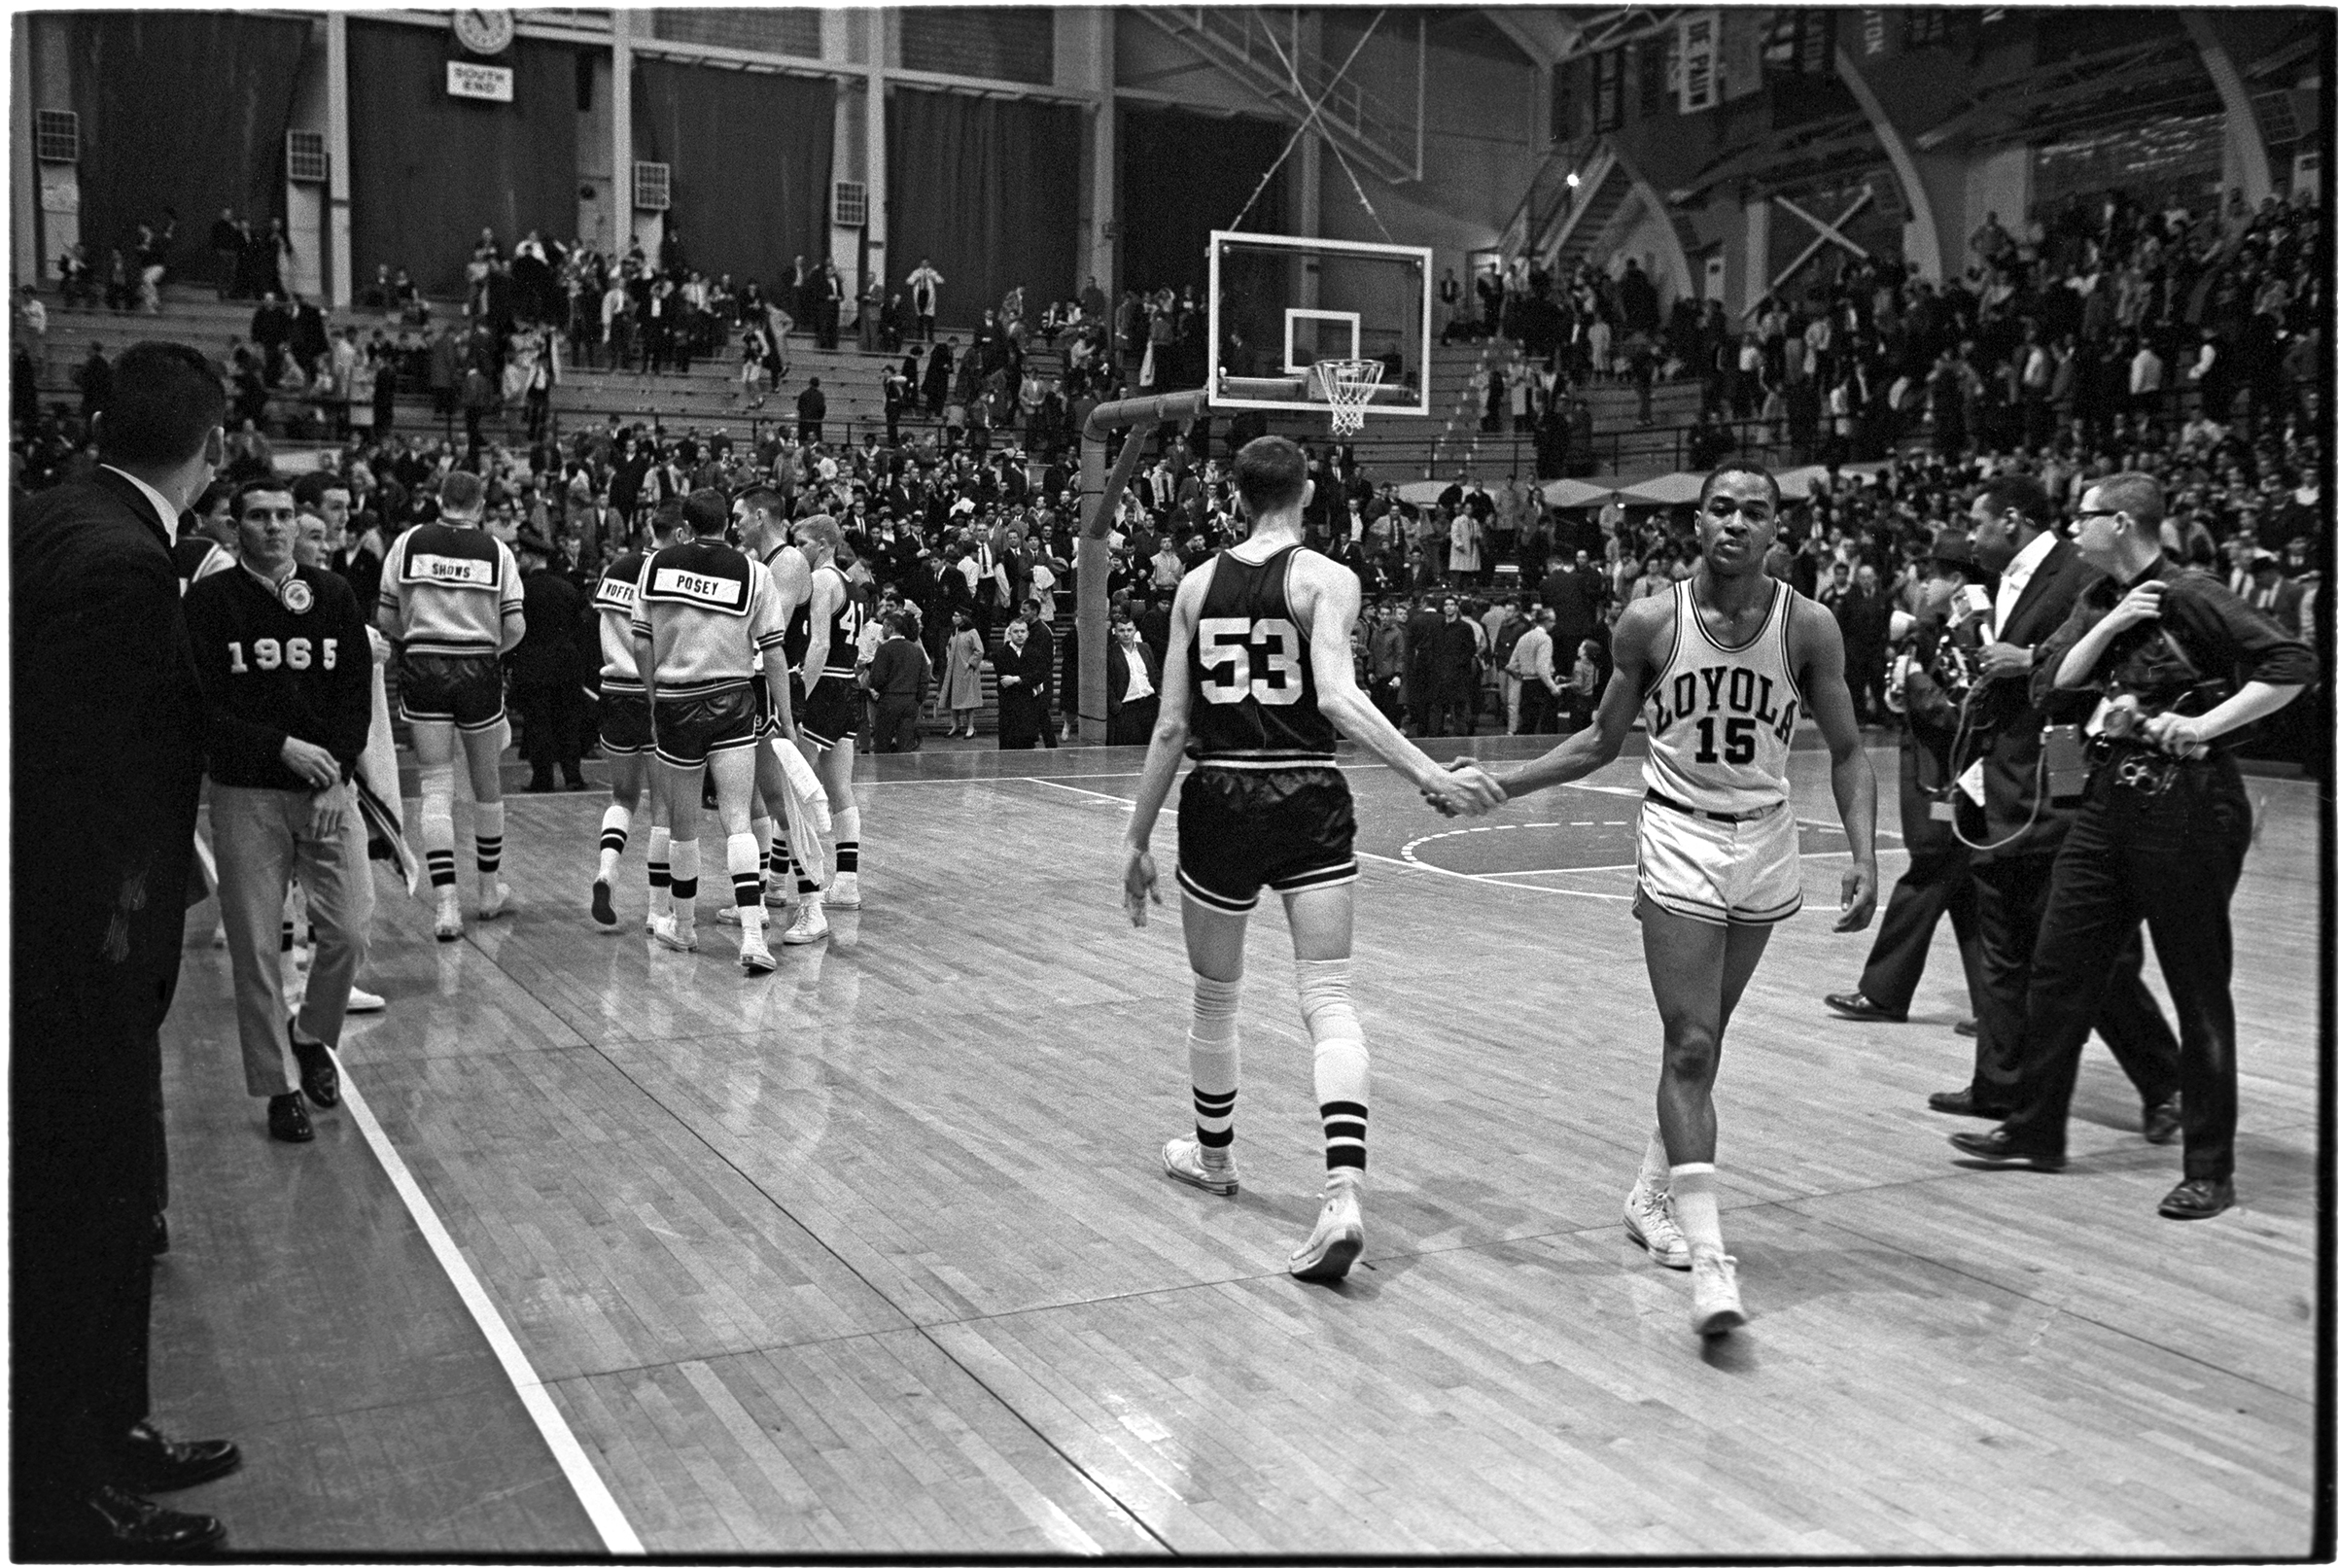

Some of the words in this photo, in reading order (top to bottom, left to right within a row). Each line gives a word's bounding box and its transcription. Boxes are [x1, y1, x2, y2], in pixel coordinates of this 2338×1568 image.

[454, 67, 505, 82] SOUTH
[463, 80, 497, 94] END
[432, 562, 471, 579] SHOWS
[676, 574, 719, 597] POSEY
[839, 600, 864, 646] 41
[227, 638, 338, 674] 1965
[1199, 616, 1304, 706] 53
[1653, 665, 1797, 746] LOYOLA
[1694, 716, 1757, 765] 15
